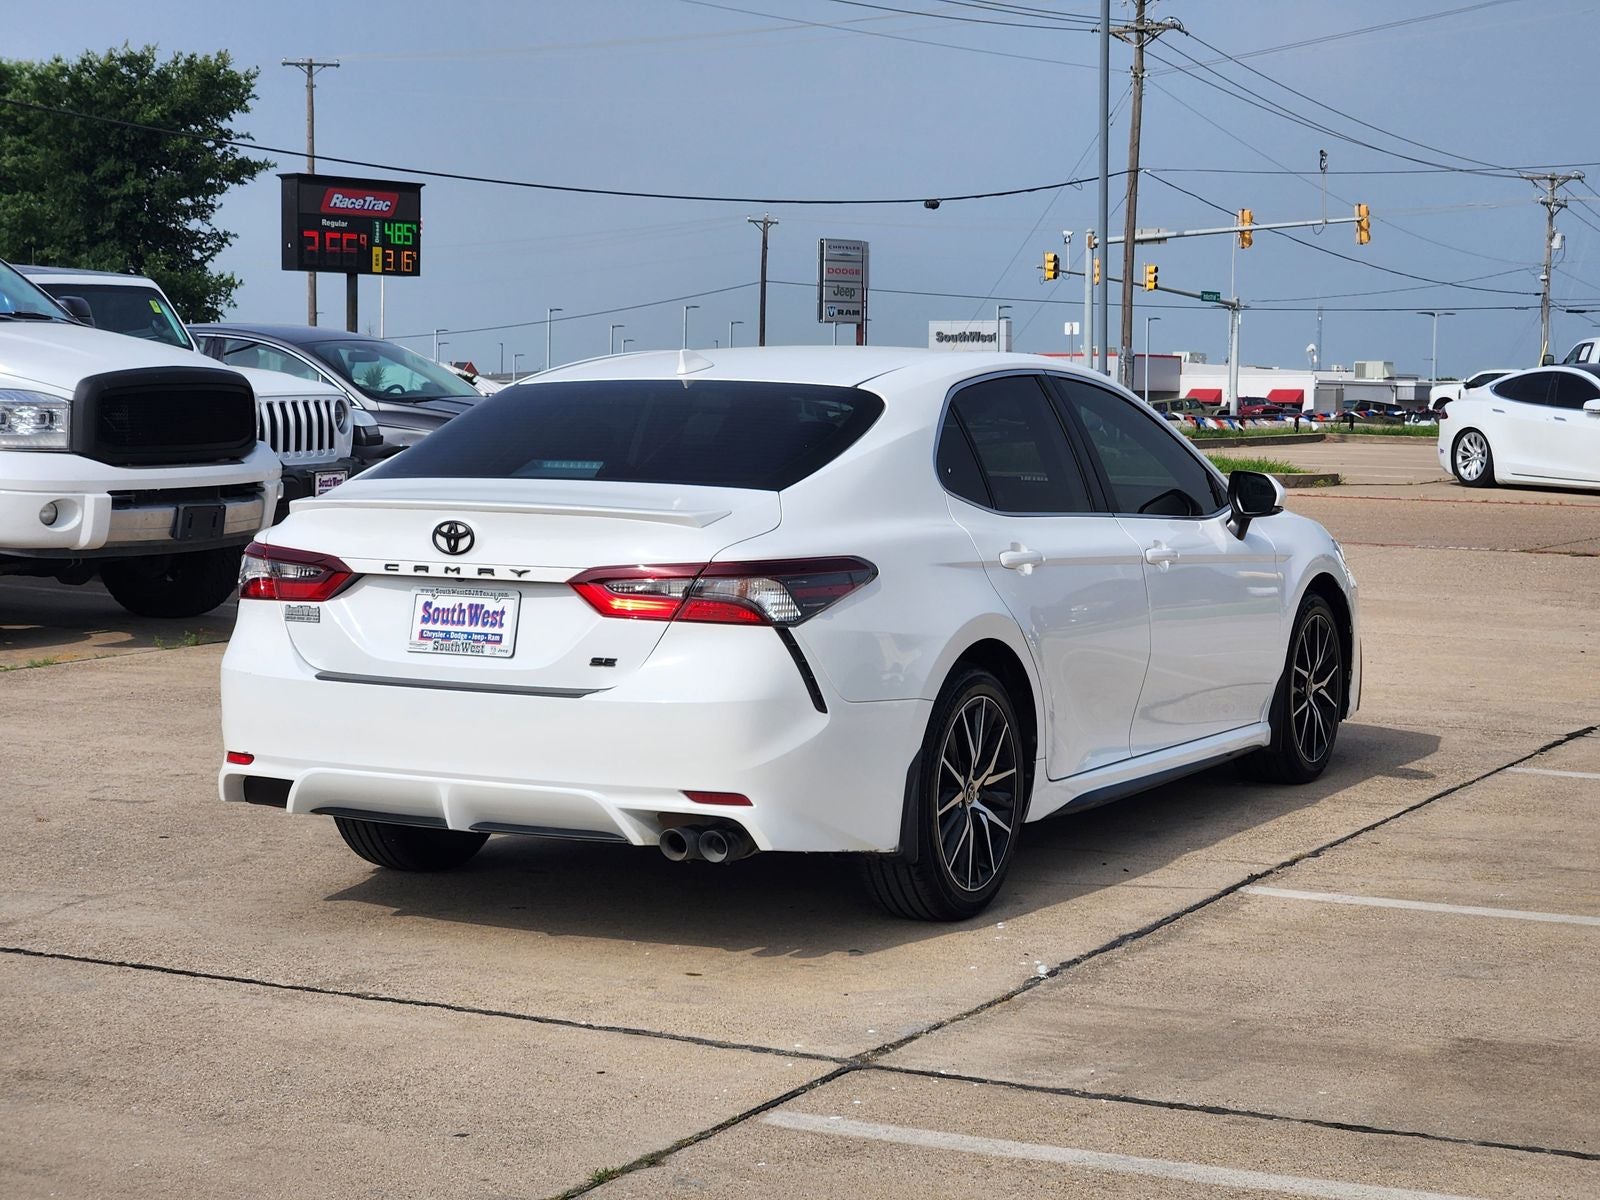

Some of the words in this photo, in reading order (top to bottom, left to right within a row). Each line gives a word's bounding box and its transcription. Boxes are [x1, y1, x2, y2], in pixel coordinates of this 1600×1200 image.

[329, 193, 391, 212] RaceTrac
[321, 219, 348, 229] Regular
[827, 267, 861, 276] DODGE
[833, 284, 856, 299] Jeep
[837, 308, 860, 316] RAM
[935, 330, 997, 344] SouthWest
[384, 563, 531, 578] CAMRY
[420, 600, 506, 628] SouthWest
[422, 630, 446, 641] Chrysler
[450, 631, 468, 642] Dodge
[471, 633, 485, 643] Jeep
[487, 634, 501, 642] Ram
[432, 640, 486, 655] SouthWest
[589, 657, 618, 667] SE
